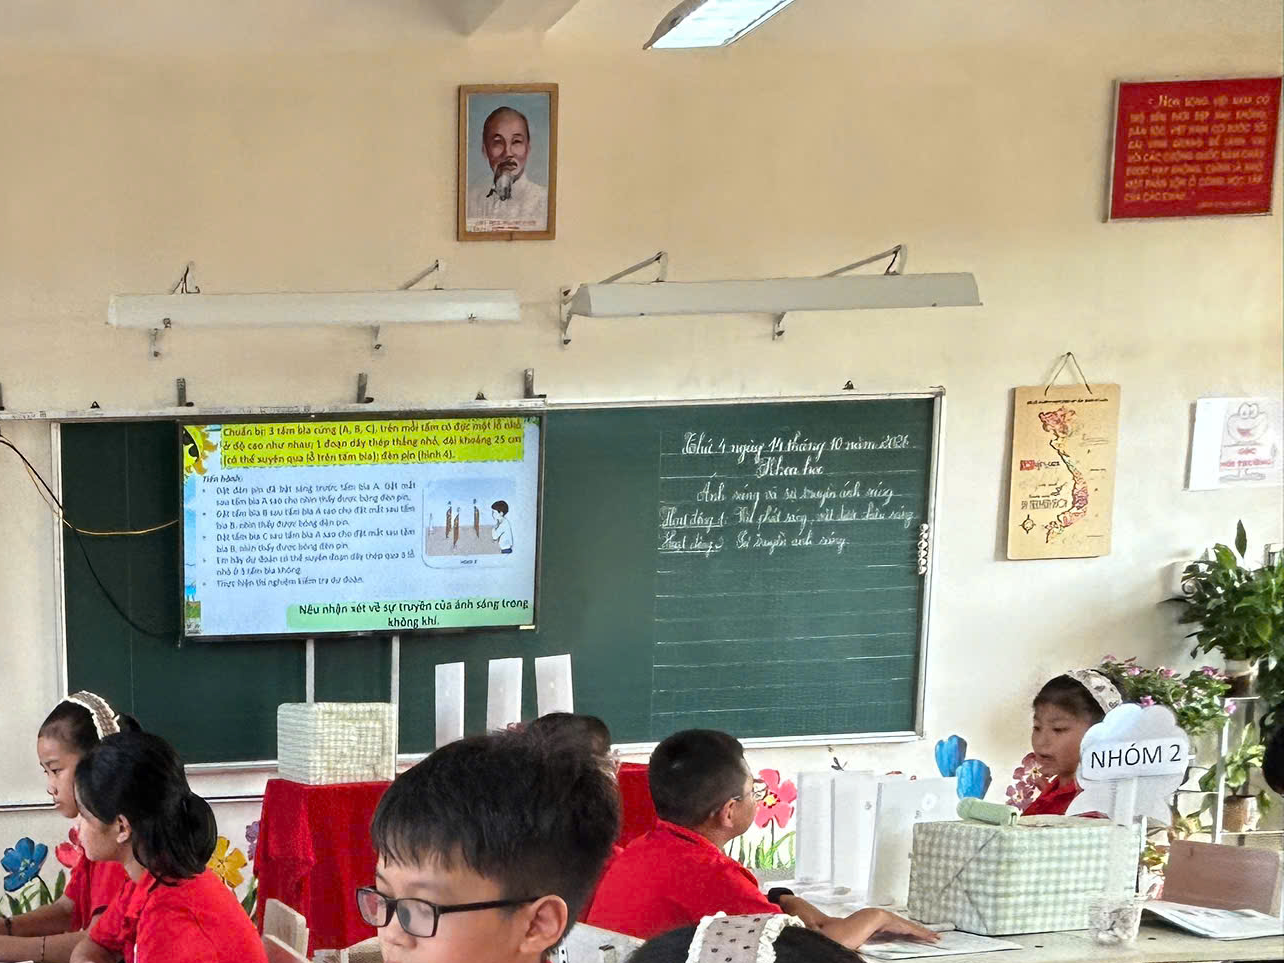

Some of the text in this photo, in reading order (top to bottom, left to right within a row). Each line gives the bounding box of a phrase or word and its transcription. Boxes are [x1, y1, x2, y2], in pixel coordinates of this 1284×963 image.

[269, 428, 275, 436] 3
[314, 425, 337, 437] cứng
[381, 422, 399, 433] trên
[233, 440, 245, 452] độ
[248, 442, 264, 450] cao
[266, 440, 284, 450] như
[324, 438, 347, 450] đoạn
[494, 435, 505, 444] 25
[731, 439, 764, 465] ngày
[787, 430, 826, 462] tháng
[830, 436, 843, 451] 10
[257, 454, 284, 465] xuyên
[287, 455, 303, 465] qua
[299, 604, 320, 615] Nêu
[322, 603, 348, 616] nhận
[455, 598, 474, 610] ánh
[476, 598, 499, 611] sáng
[502, 598, 529, 610] trong
[388, 616, 419, 630] không
[1091, 743, 1182, 769] NHÓM 2
